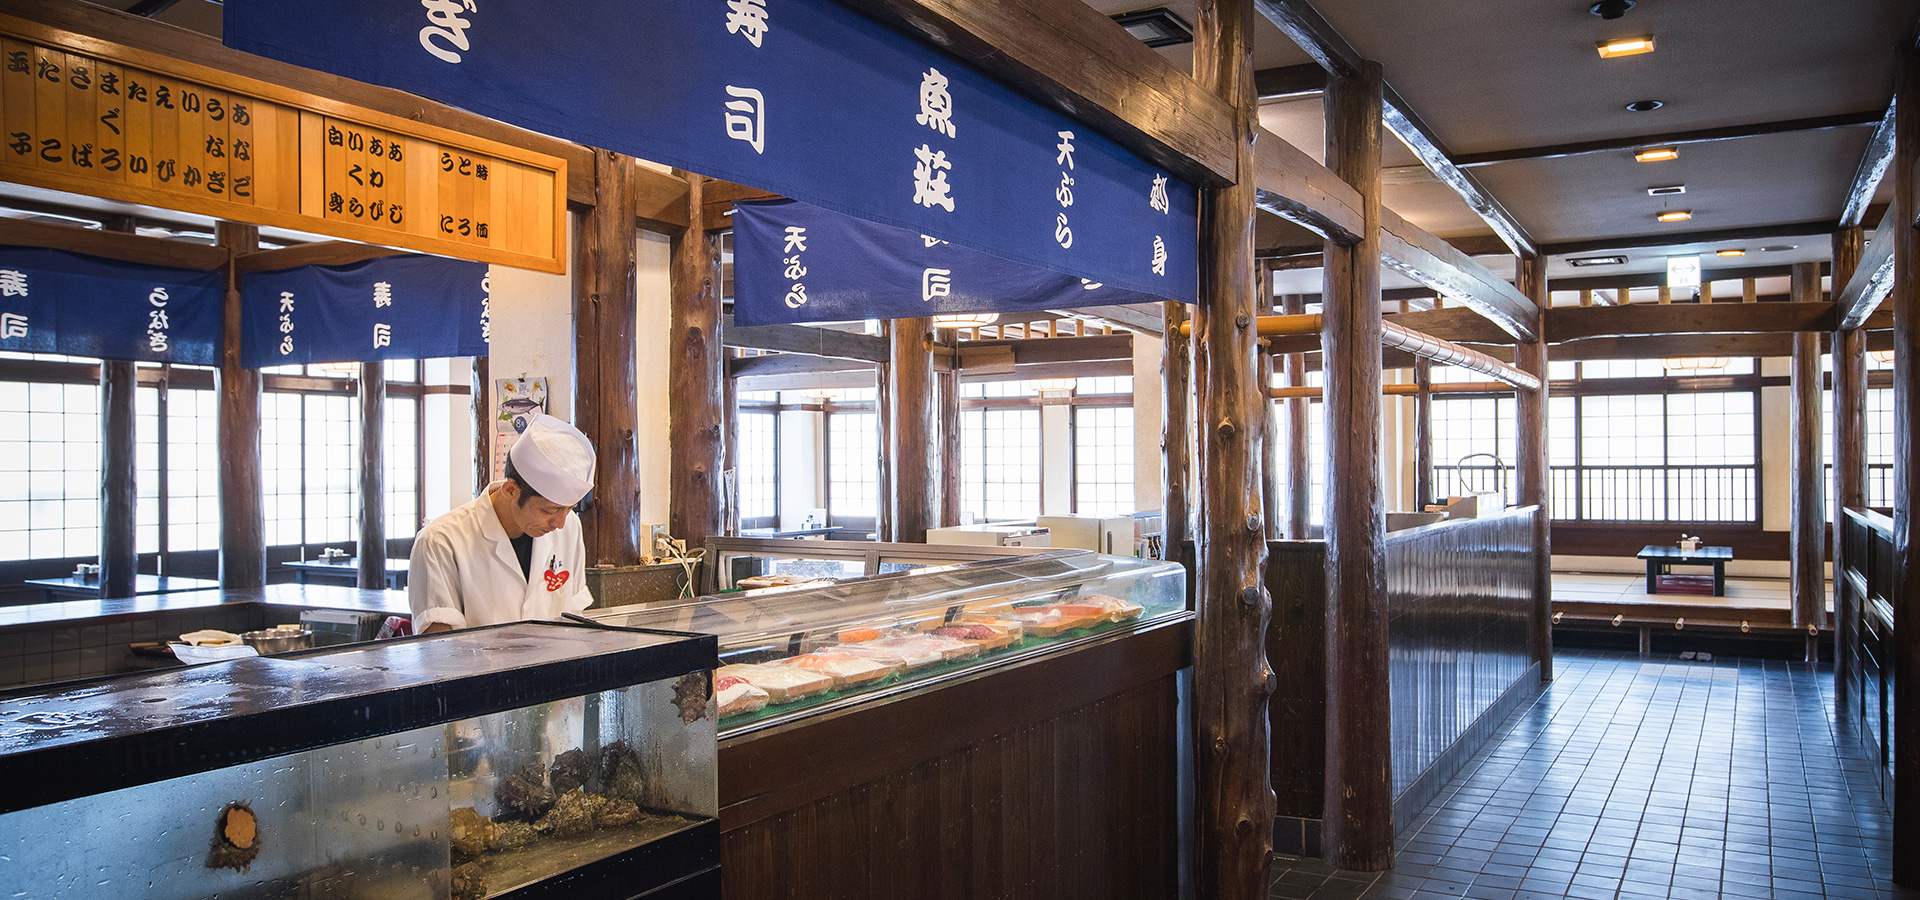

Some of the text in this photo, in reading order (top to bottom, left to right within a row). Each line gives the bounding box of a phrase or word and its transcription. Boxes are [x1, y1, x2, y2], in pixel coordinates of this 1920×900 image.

[7, 51, 33, 156] 玉子
[37, 56, 63, 163] たこ
[70, 66, 93, 168] さば
[100, 72, 122, 172] まぐろ
[127, 81, 148, 174] たい
[155, 85, 176, 182] えび
[182, 90, 202, 187] いか
[206, 98, 227, 194] うなぎ
[232, 103, 251, 197] あなご
[328, 125, 344, 214] 白身
[348, 131, 364, 218] いくら
[369, 136, 384, 221] あわび
[388, 142, 403, 224] あじ
[440, 152, 454, 234] うに
[458, 156, 471, 236] とろ
[475, 164, 489, 239] 時価
[1055, 131, 1075, 249] 天ぷら
[1150, 173, 1169, 277] 刺身
